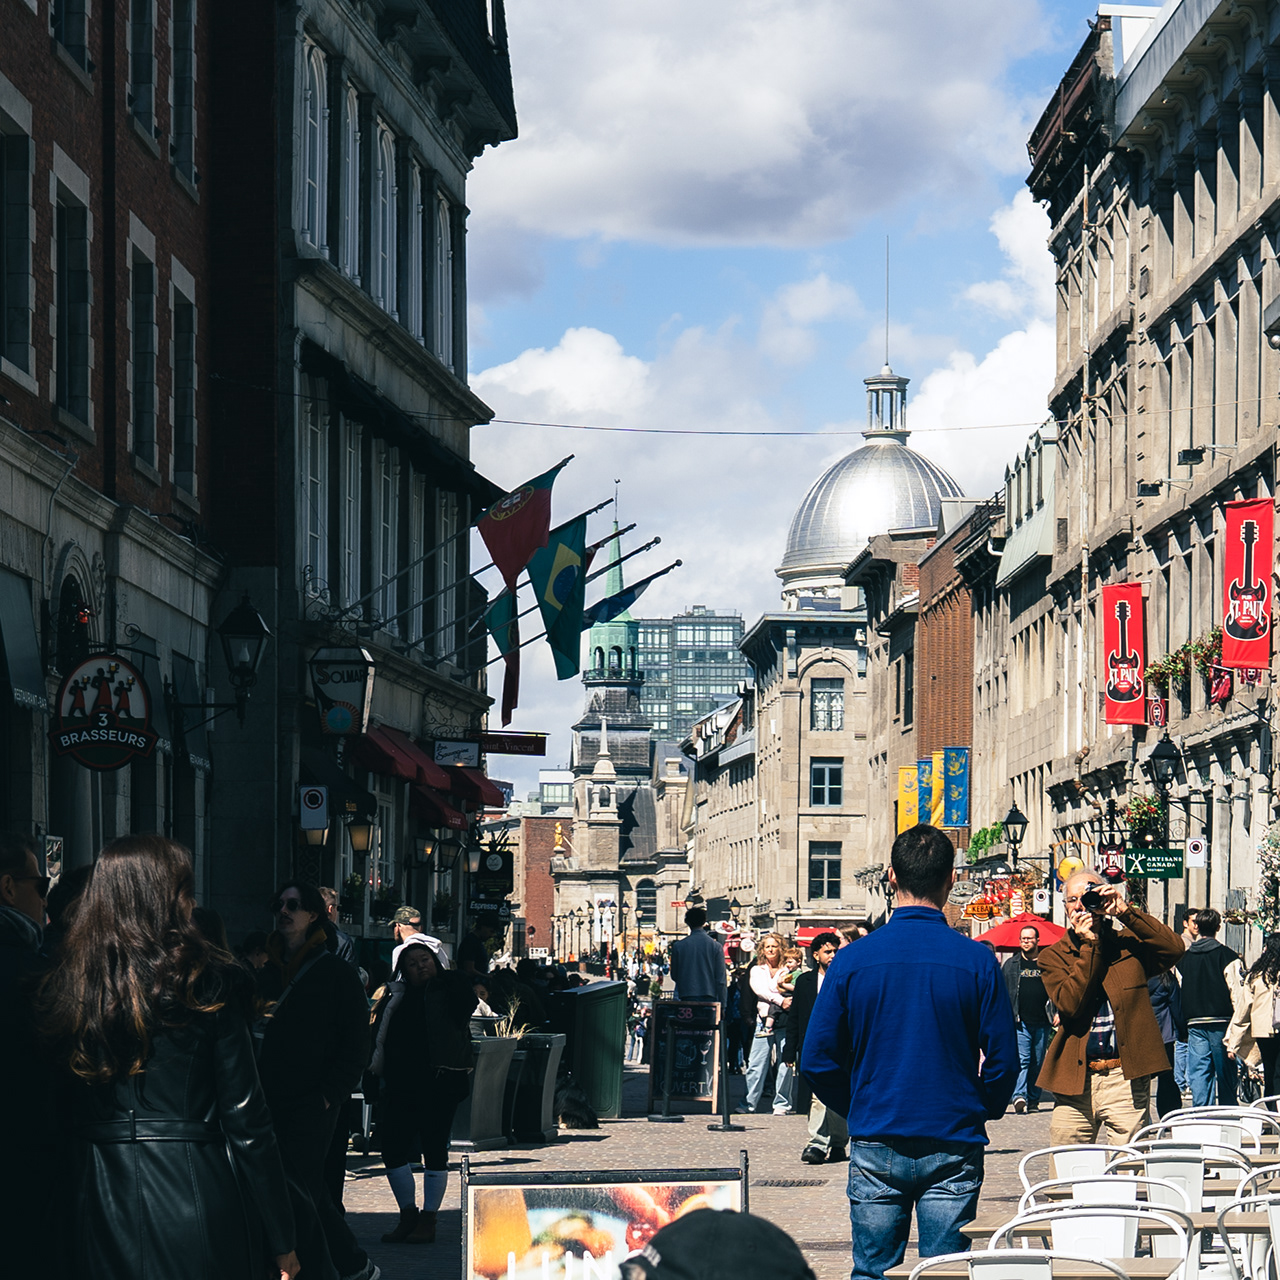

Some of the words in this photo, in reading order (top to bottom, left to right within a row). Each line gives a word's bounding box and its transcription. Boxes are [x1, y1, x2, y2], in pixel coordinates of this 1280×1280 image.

[98, 713, 108, 727] 3
[60, 729, 147, 748] BRASSEURS
[470, 901, 498, 910] Espresso
